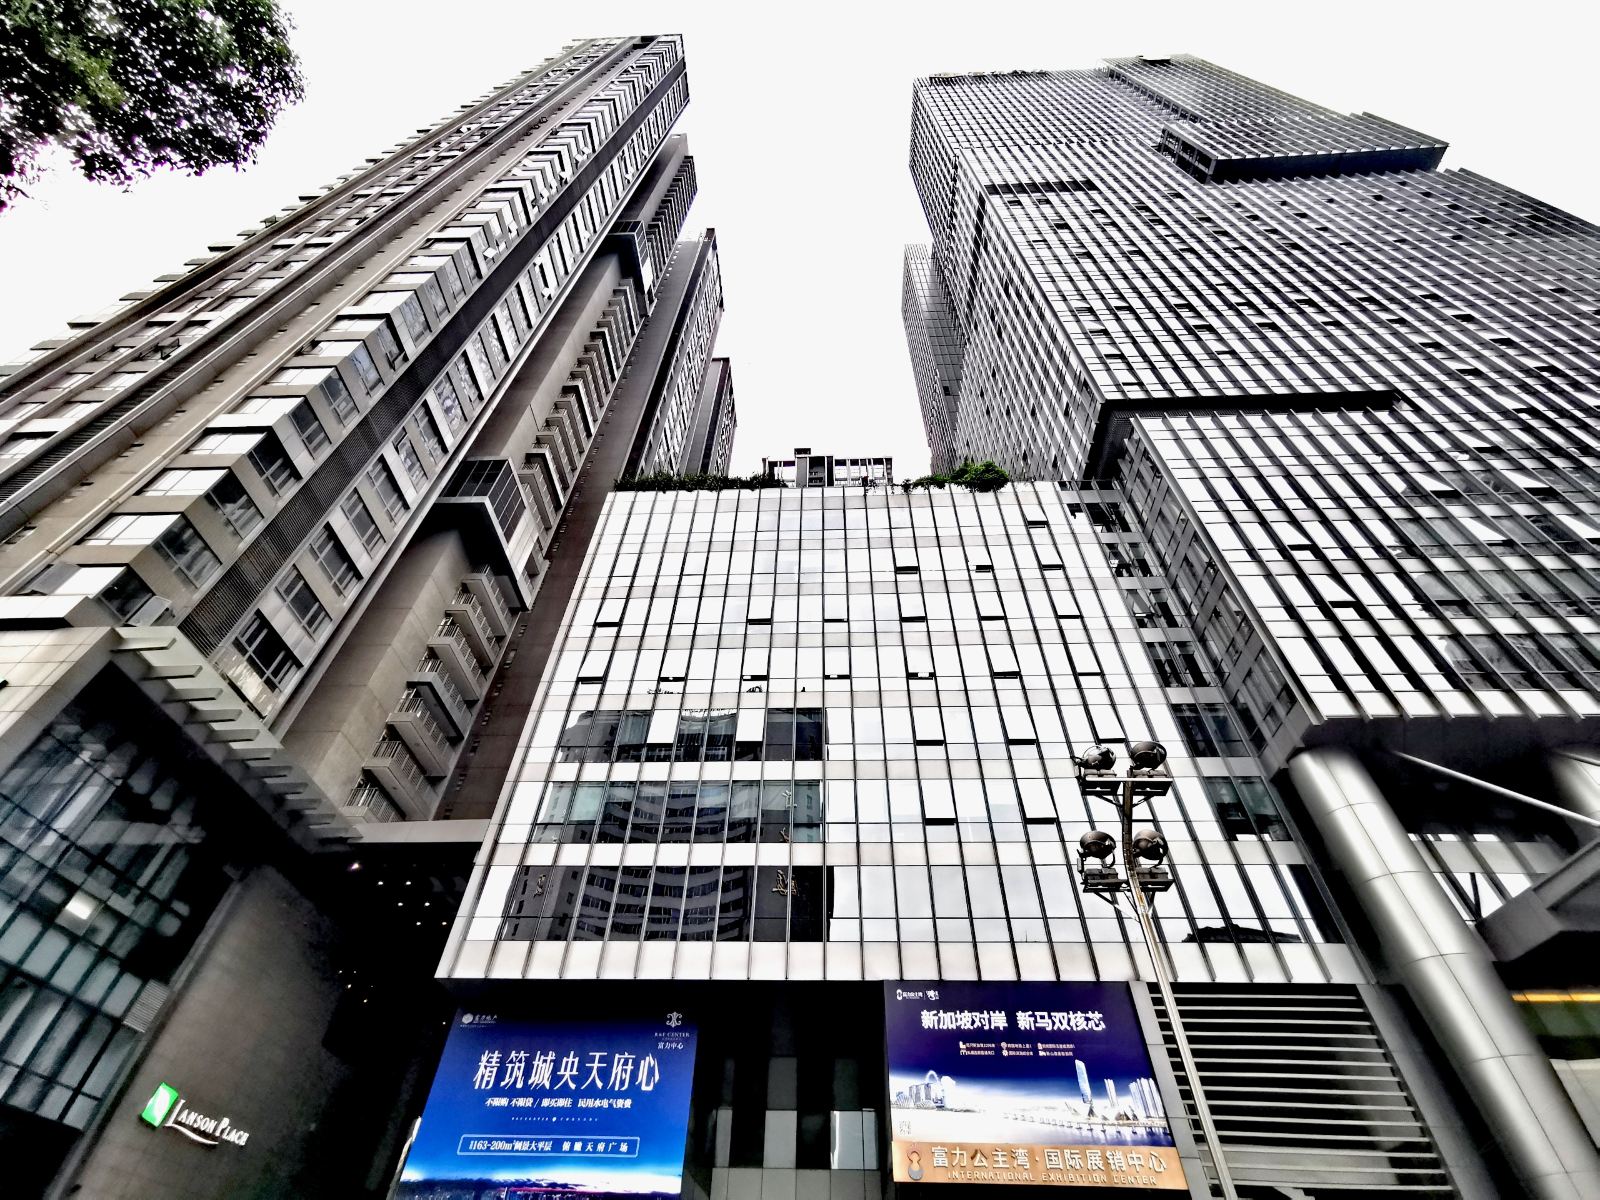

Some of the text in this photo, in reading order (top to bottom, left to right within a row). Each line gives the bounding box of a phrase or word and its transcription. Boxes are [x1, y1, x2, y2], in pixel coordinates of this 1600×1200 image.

[920, 1009, 1106, 1031] 新加坡对岸 新马双核芯
[473, 1050, 661, 1091] 精筑城央天府心
[948, 1170, 1158, 1186] INTERNATIONAL EXHIBITION CENTER
